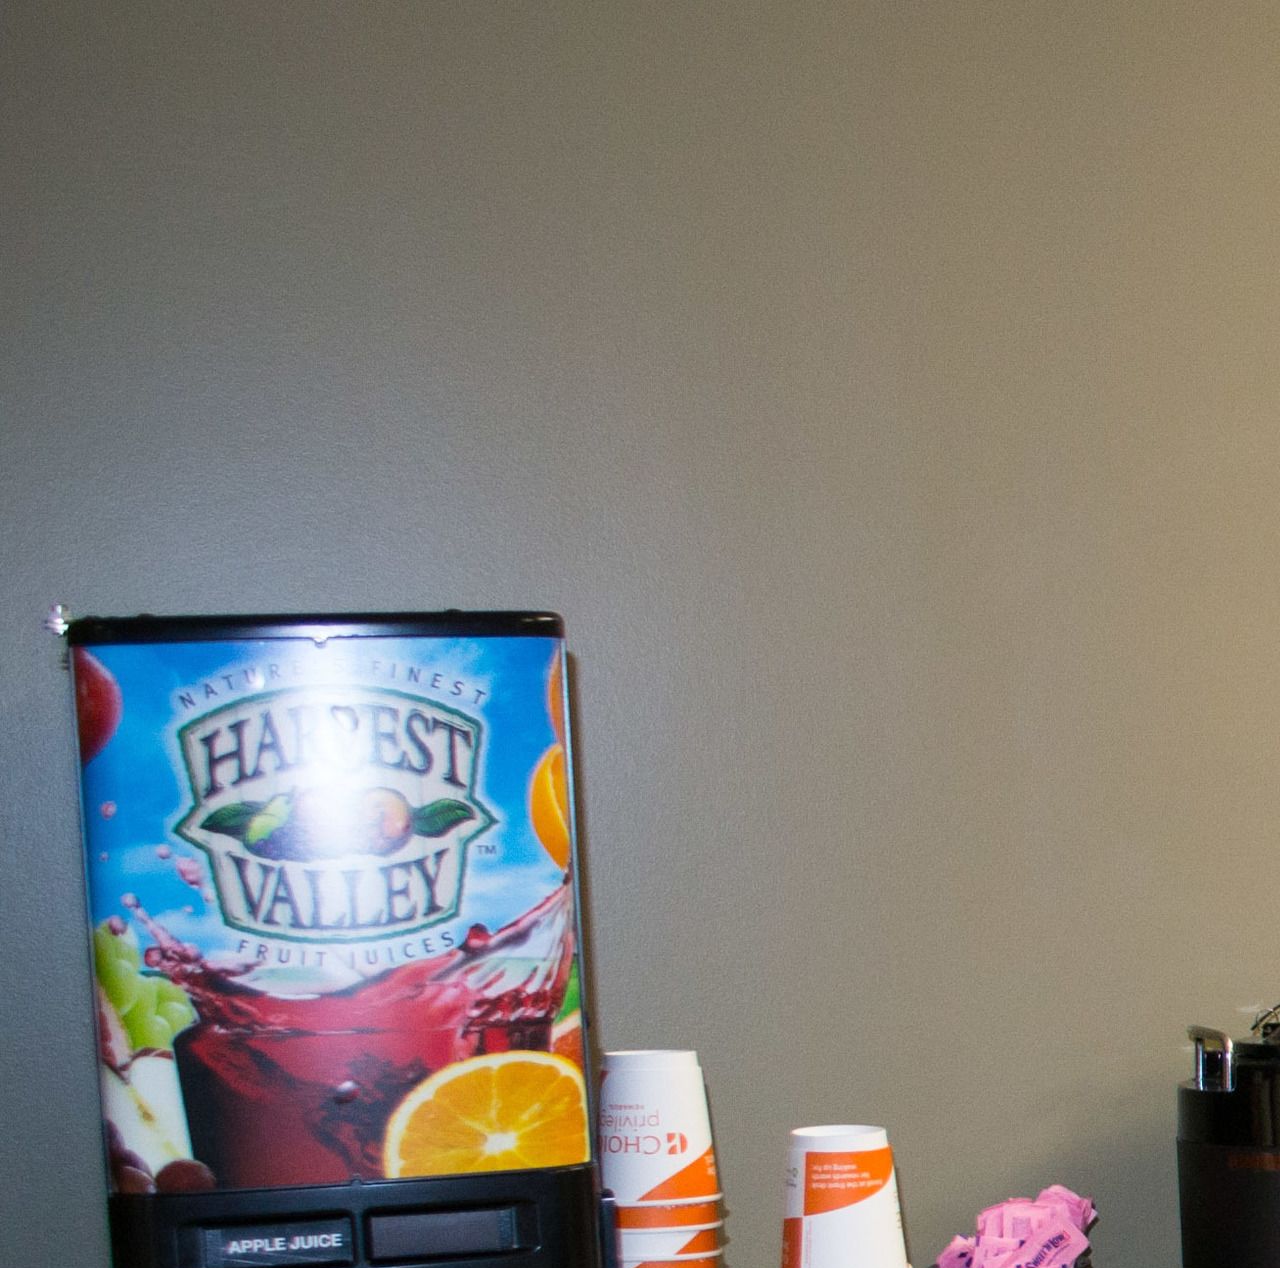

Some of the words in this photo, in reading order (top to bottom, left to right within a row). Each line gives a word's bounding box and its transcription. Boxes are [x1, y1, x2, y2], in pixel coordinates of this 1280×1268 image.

[372, 659, 488, 705] FINEST
[200, 704, 474, 800] HAEST
[226, 847, 451, 930] VALLEY
[236, 938, 328, 968] FRUIT
[349, 931, 455, 970] JUICES
[598, 1135, 661, 1155] CHOI
[228, 1236, 288, 1255] APPLE
[289, 1232, 344, 1251] JUICE
